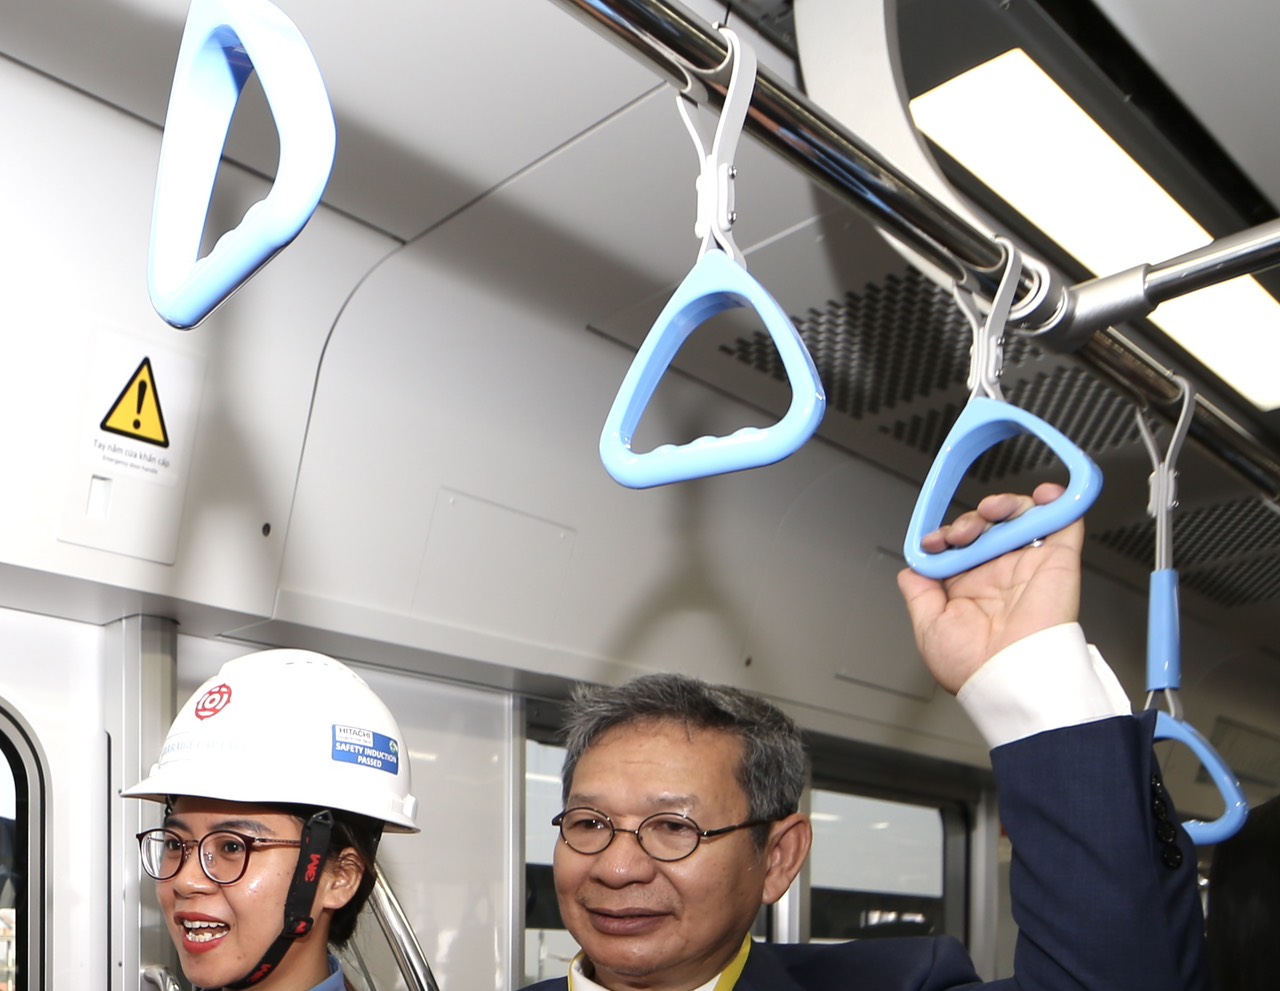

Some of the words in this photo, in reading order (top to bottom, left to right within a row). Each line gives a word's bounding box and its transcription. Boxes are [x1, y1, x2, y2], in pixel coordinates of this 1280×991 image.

[339, 727, 372, 740] HITACHI
[335, 741, 364, 755] SAFETY
[364, 746, 397, 764] INDUCTION
[357, 754, 383, 768] PASSED
